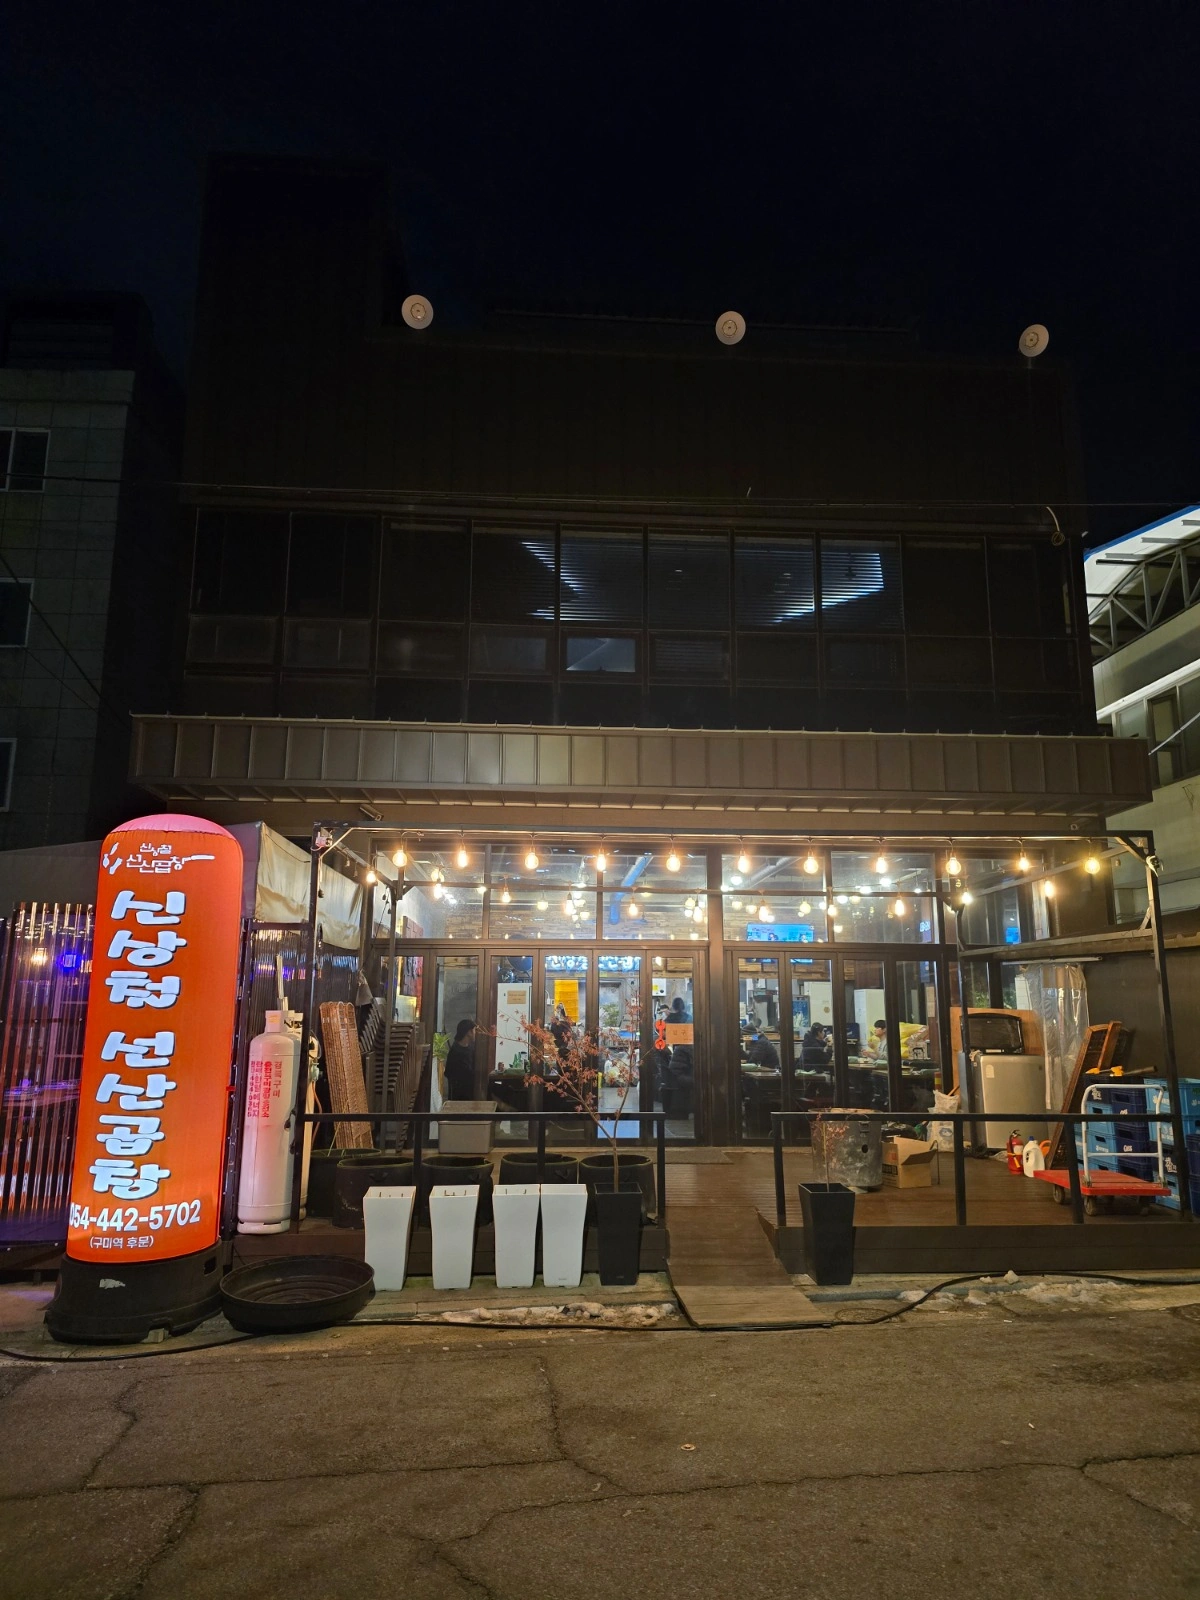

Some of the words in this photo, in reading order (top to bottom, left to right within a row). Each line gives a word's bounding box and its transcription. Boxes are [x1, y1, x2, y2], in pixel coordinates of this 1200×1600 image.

[126, 854, 192, 874] 선산곱창
[89, 1031, 177, 1199] 선산곱창
[68, 1199, 201, 1232] 054-442-5702
[89, 1235, 124, 1249] (구미역
[126, 1235, 155, 1249] 후문)
